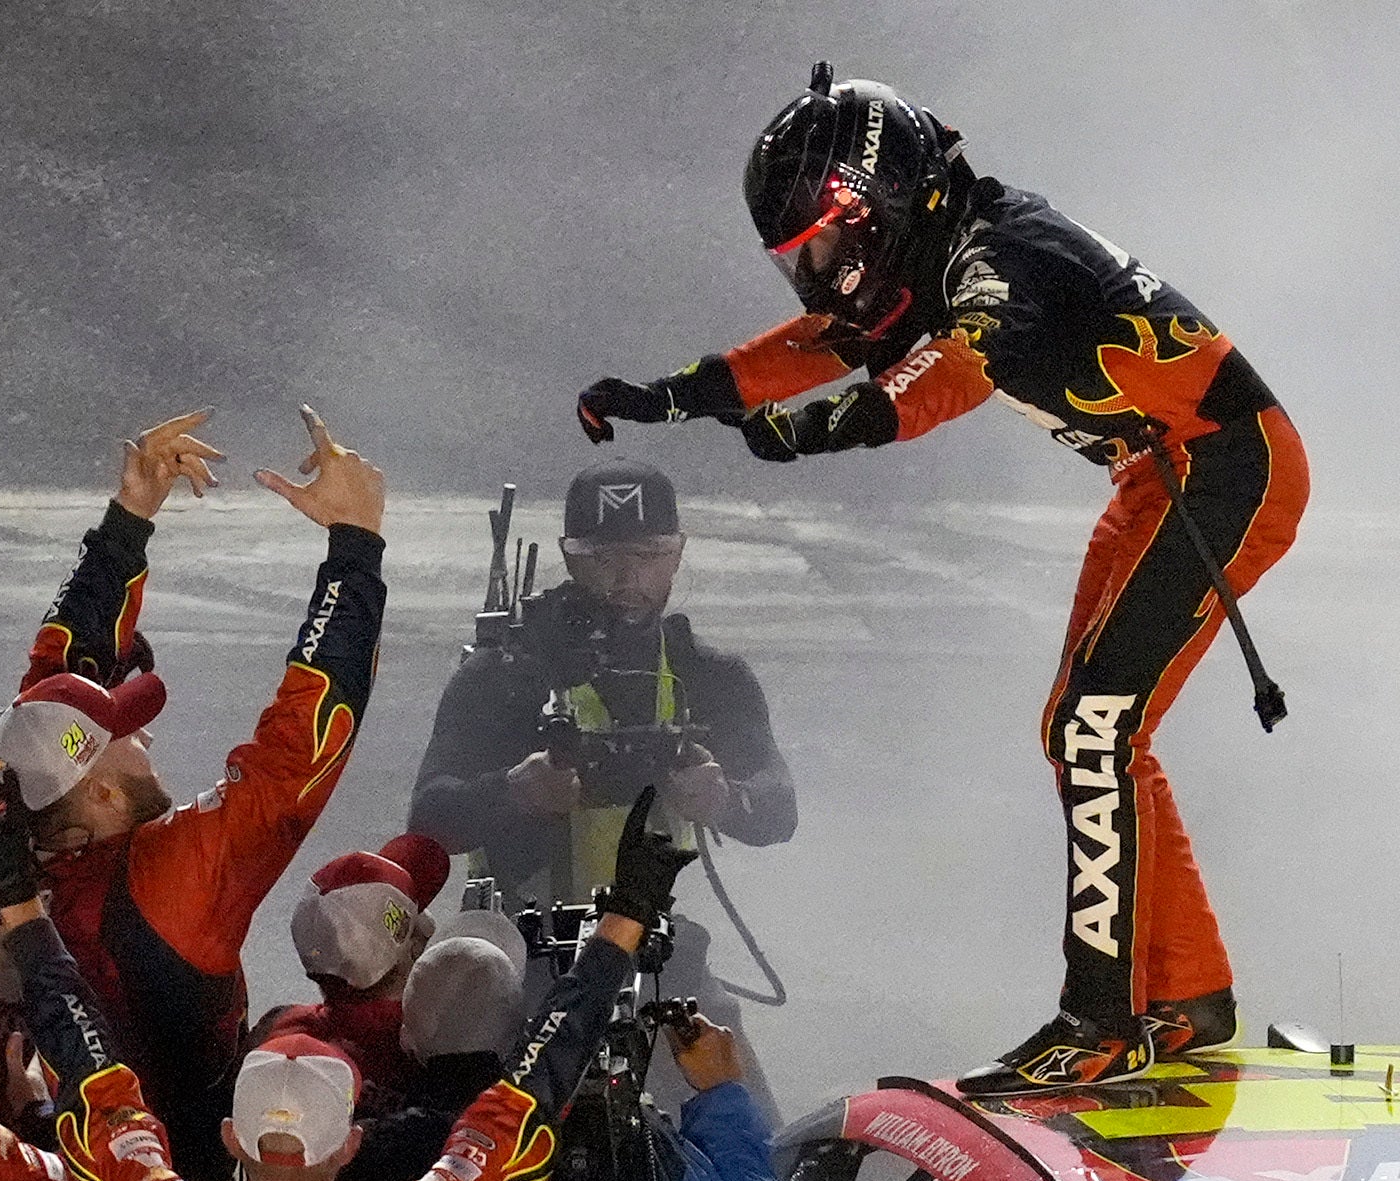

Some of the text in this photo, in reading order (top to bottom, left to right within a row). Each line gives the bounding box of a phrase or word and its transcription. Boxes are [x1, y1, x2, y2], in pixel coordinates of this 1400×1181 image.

[862, 100, 885, 175] AXALTA
[883, 350, 943, 401] XALTA
[302, 579, 343, 664] AXALTA
[61, 721, 87, 758] 24
[1064, 694, 1137, 958] AXALTA
[61, 993, 107, 1070] AXALTA
[512, 1011, 568, 1085] AXALTA
[1126, 1043, 1147, 1071] 24
[863, 1111, 936, 1158] WILLIAM
